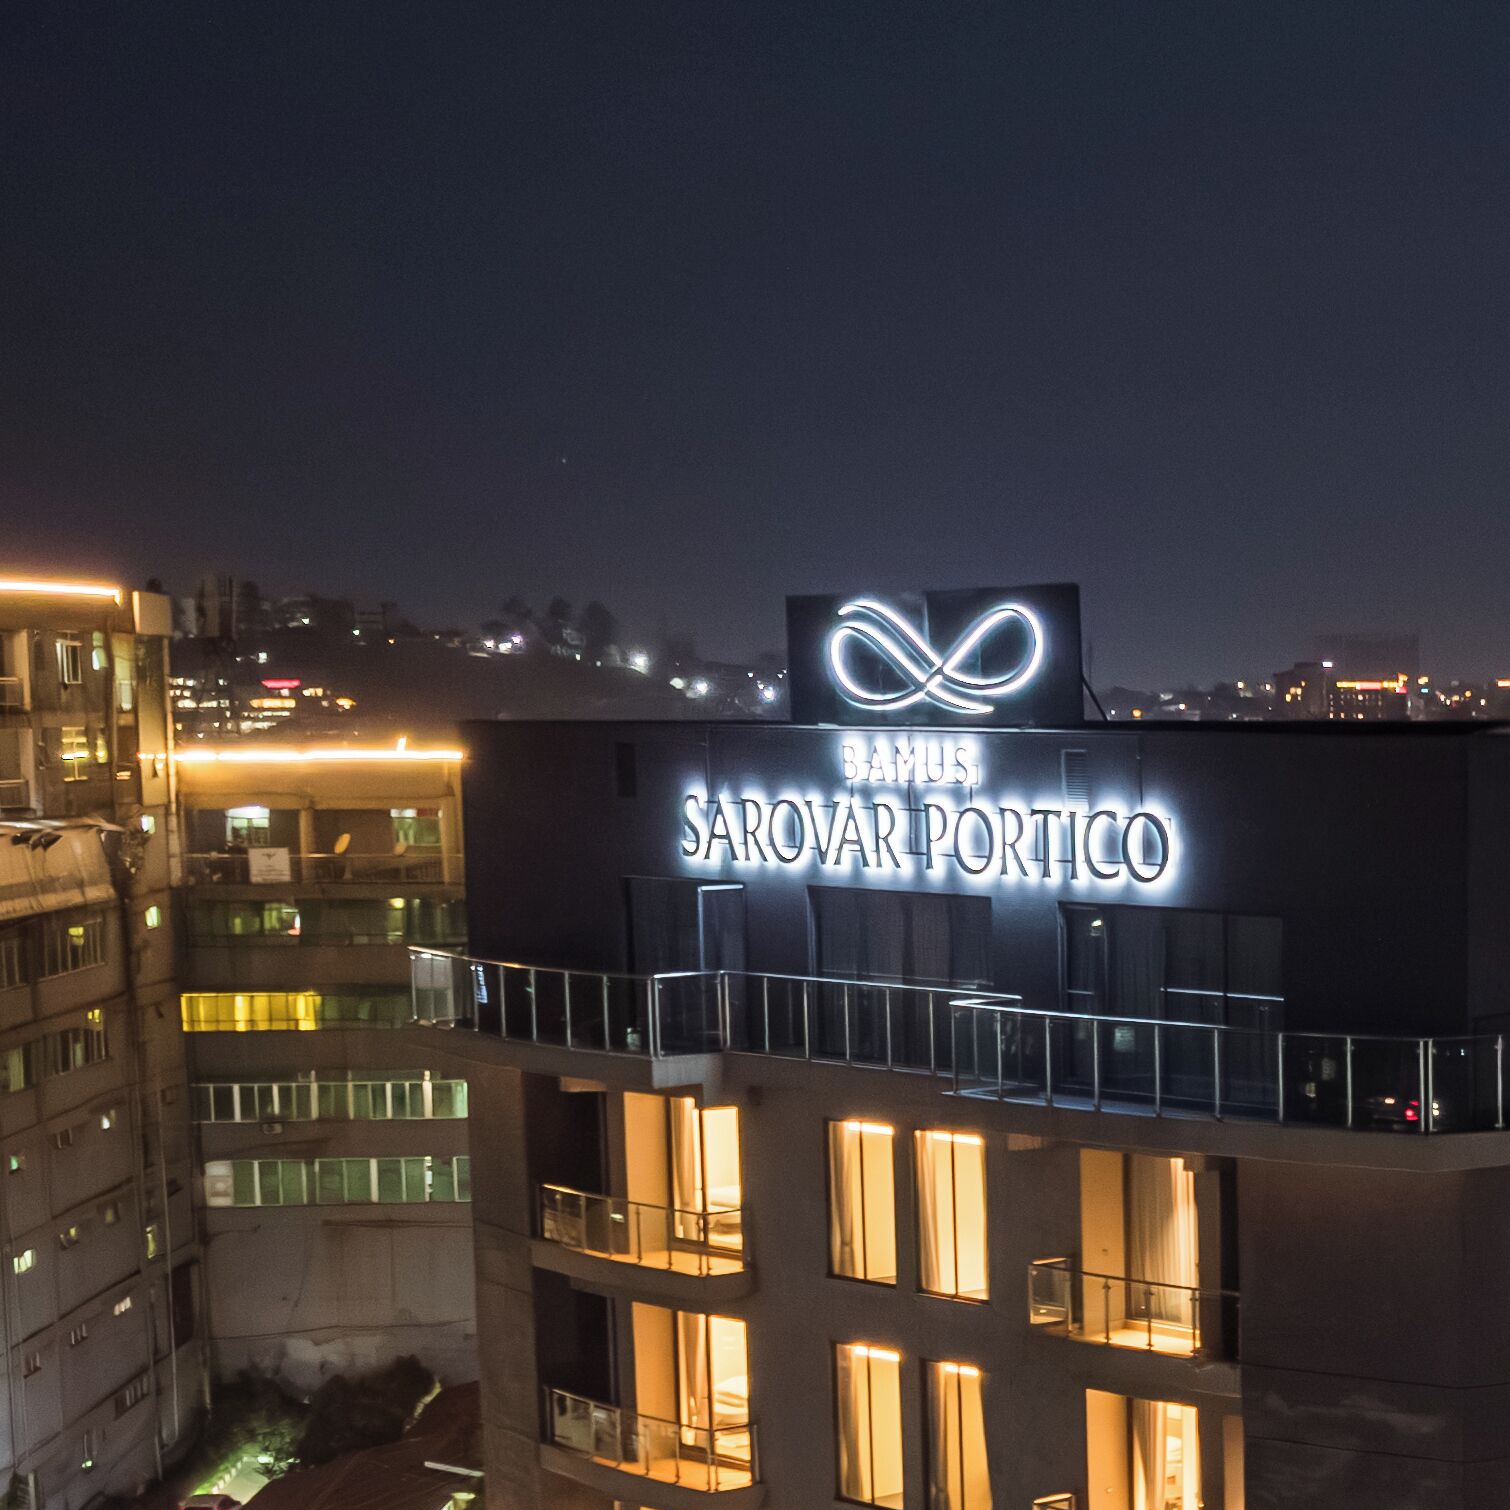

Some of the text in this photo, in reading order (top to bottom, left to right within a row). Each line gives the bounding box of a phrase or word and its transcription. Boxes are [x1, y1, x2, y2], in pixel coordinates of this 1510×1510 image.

[842, 744, 968, 784] BAMUS
[682, 795, 1170, 883] SAROVAR PORTICO
